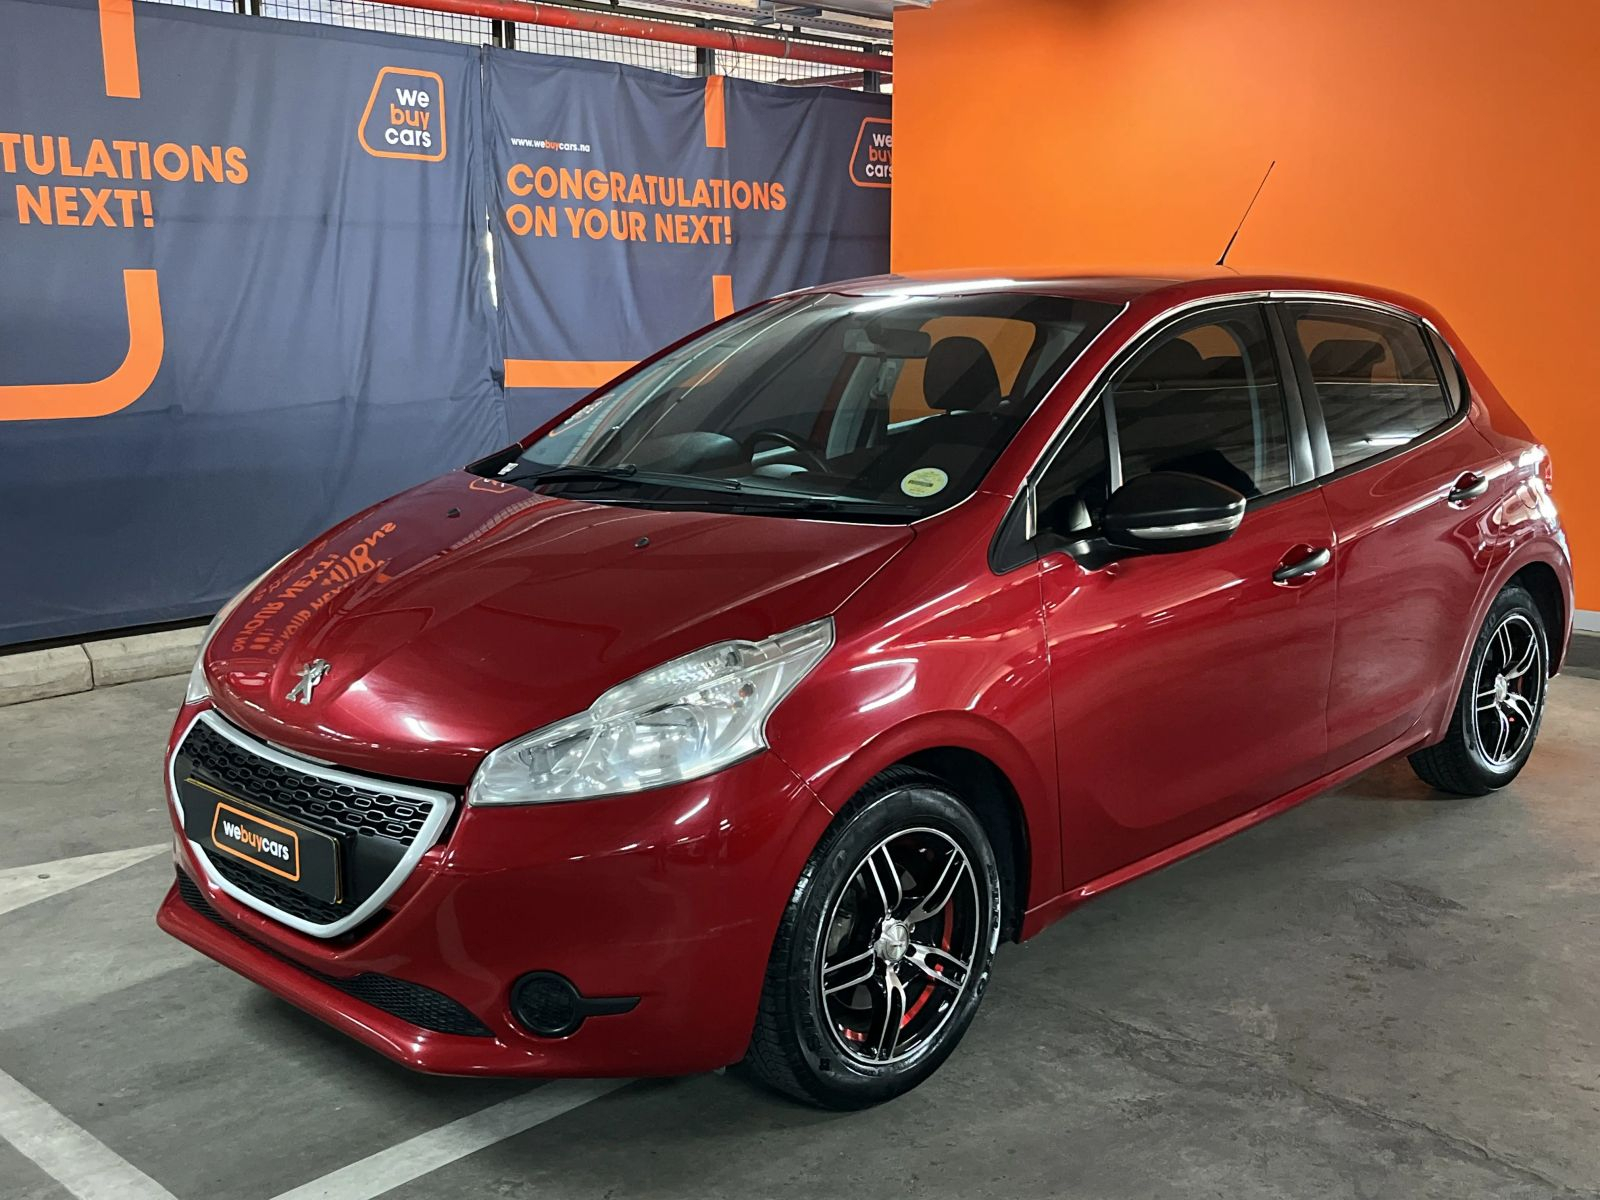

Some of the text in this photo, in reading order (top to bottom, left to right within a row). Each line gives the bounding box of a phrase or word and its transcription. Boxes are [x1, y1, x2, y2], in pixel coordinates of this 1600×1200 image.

[395, 88, 430, 108] we
[390, 103, 430, 130] buy
[384, 128, 432, 148] cars
[510, 138, 591, 153] www.webuycars.na
[872, 133, 892, 148] we
[0, 132, 249, 184] TULATIONS
[506, 163, 787, 211] CONGRATULATIONS
[15, 184, 155, 228] NEXT!
[506, 203, 732, 245] ON YOUR NEXT!
[223, 820, 290, 861] webuycars
